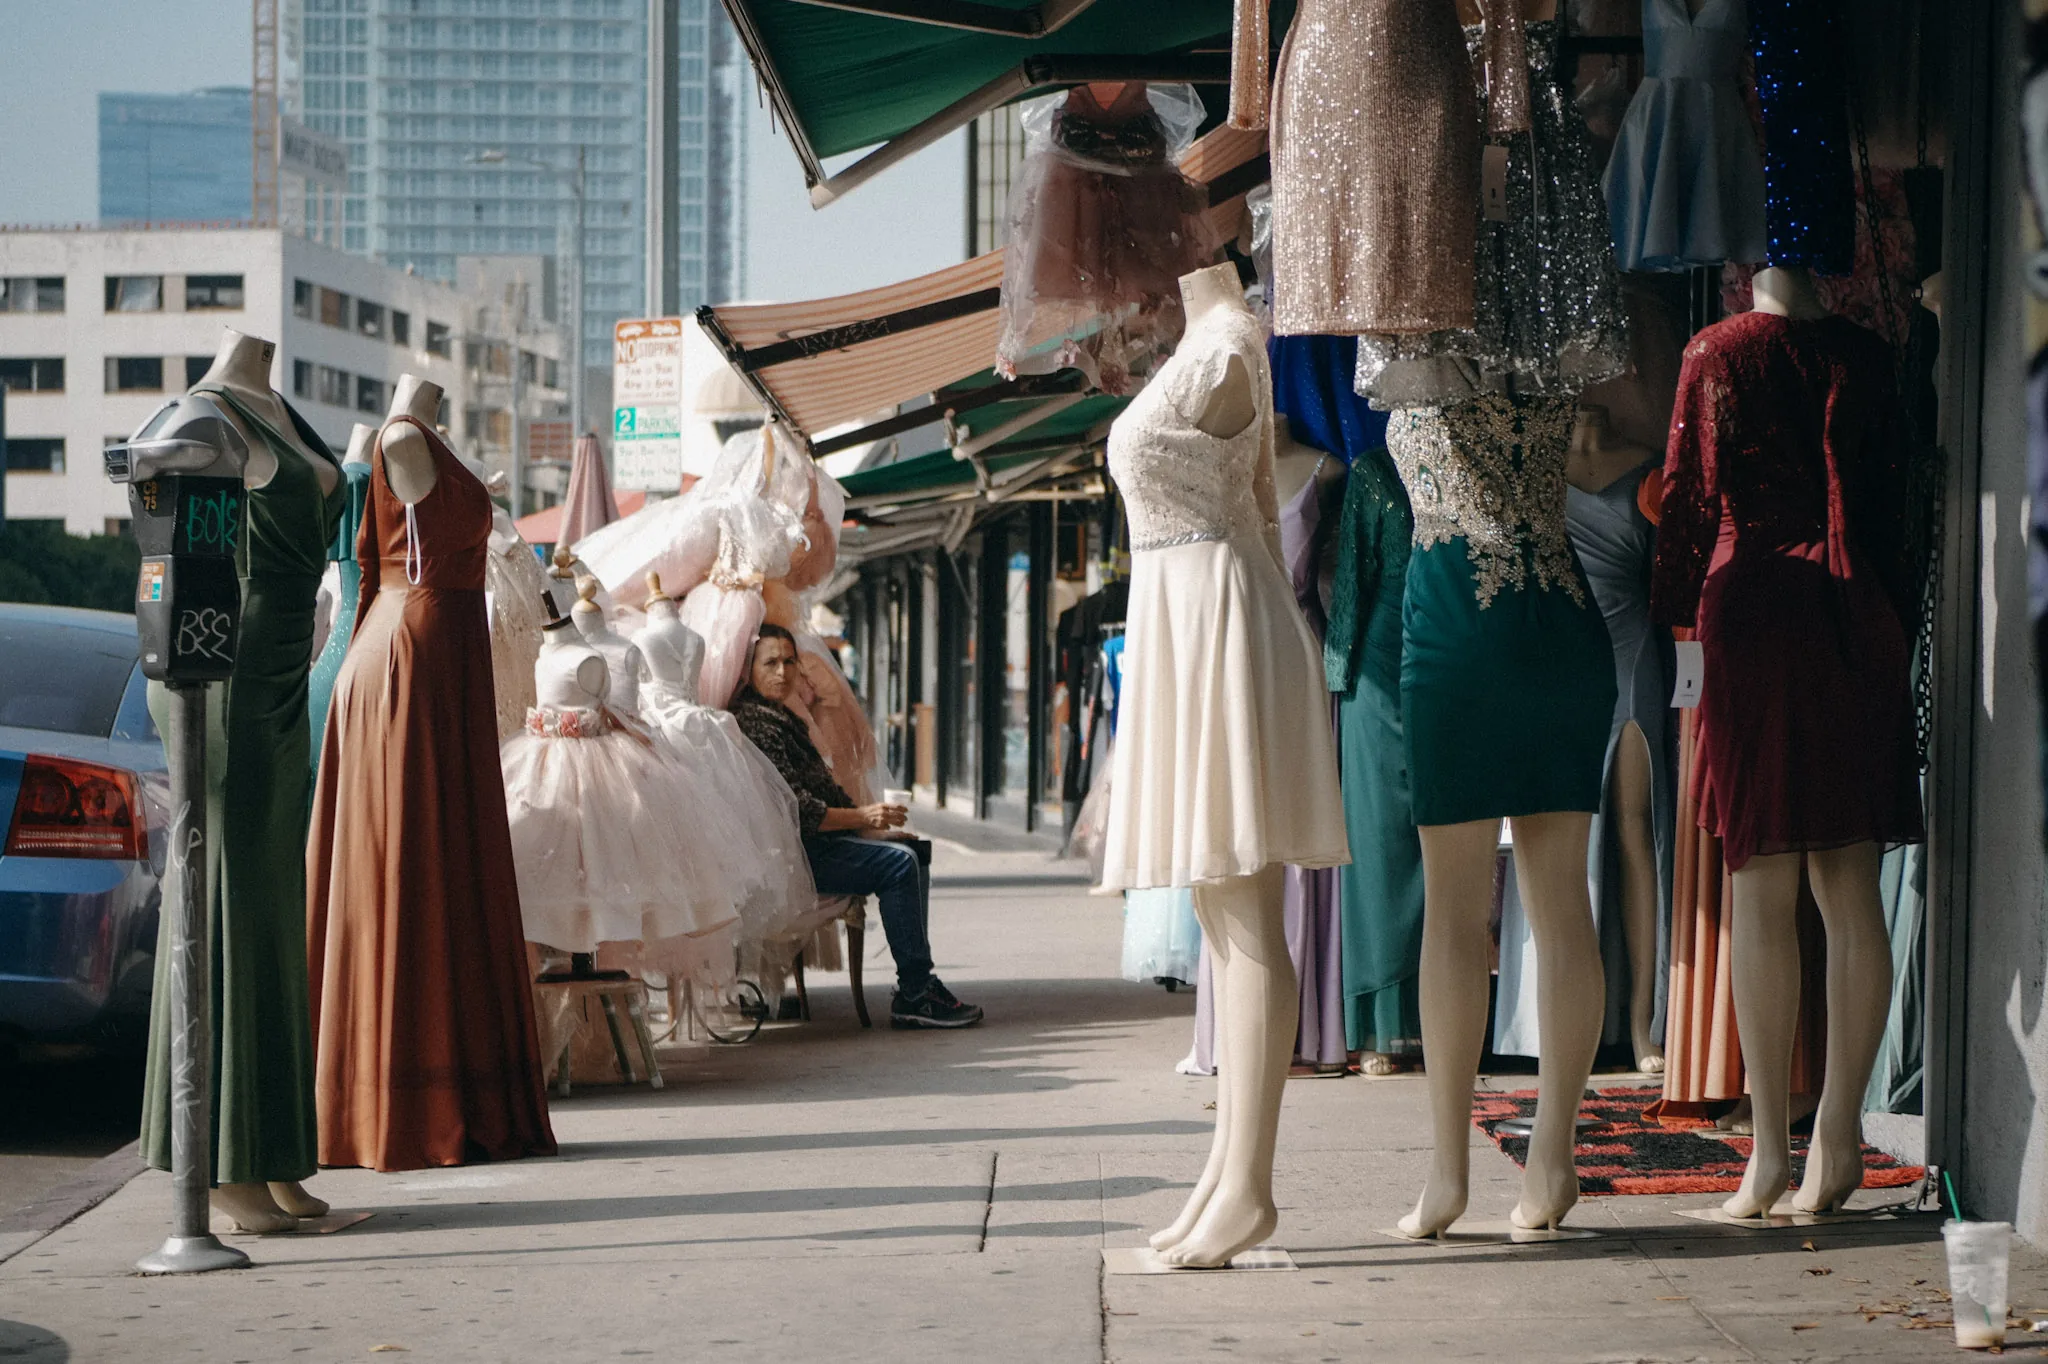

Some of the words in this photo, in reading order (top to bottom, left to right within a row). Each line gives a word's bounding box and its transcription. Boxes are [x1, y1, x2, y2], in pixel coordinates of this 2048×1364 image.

[616, 340, 637, 363] NO
[619, 409, 631, 432] 2
[143, 495, 157, 510] 75
